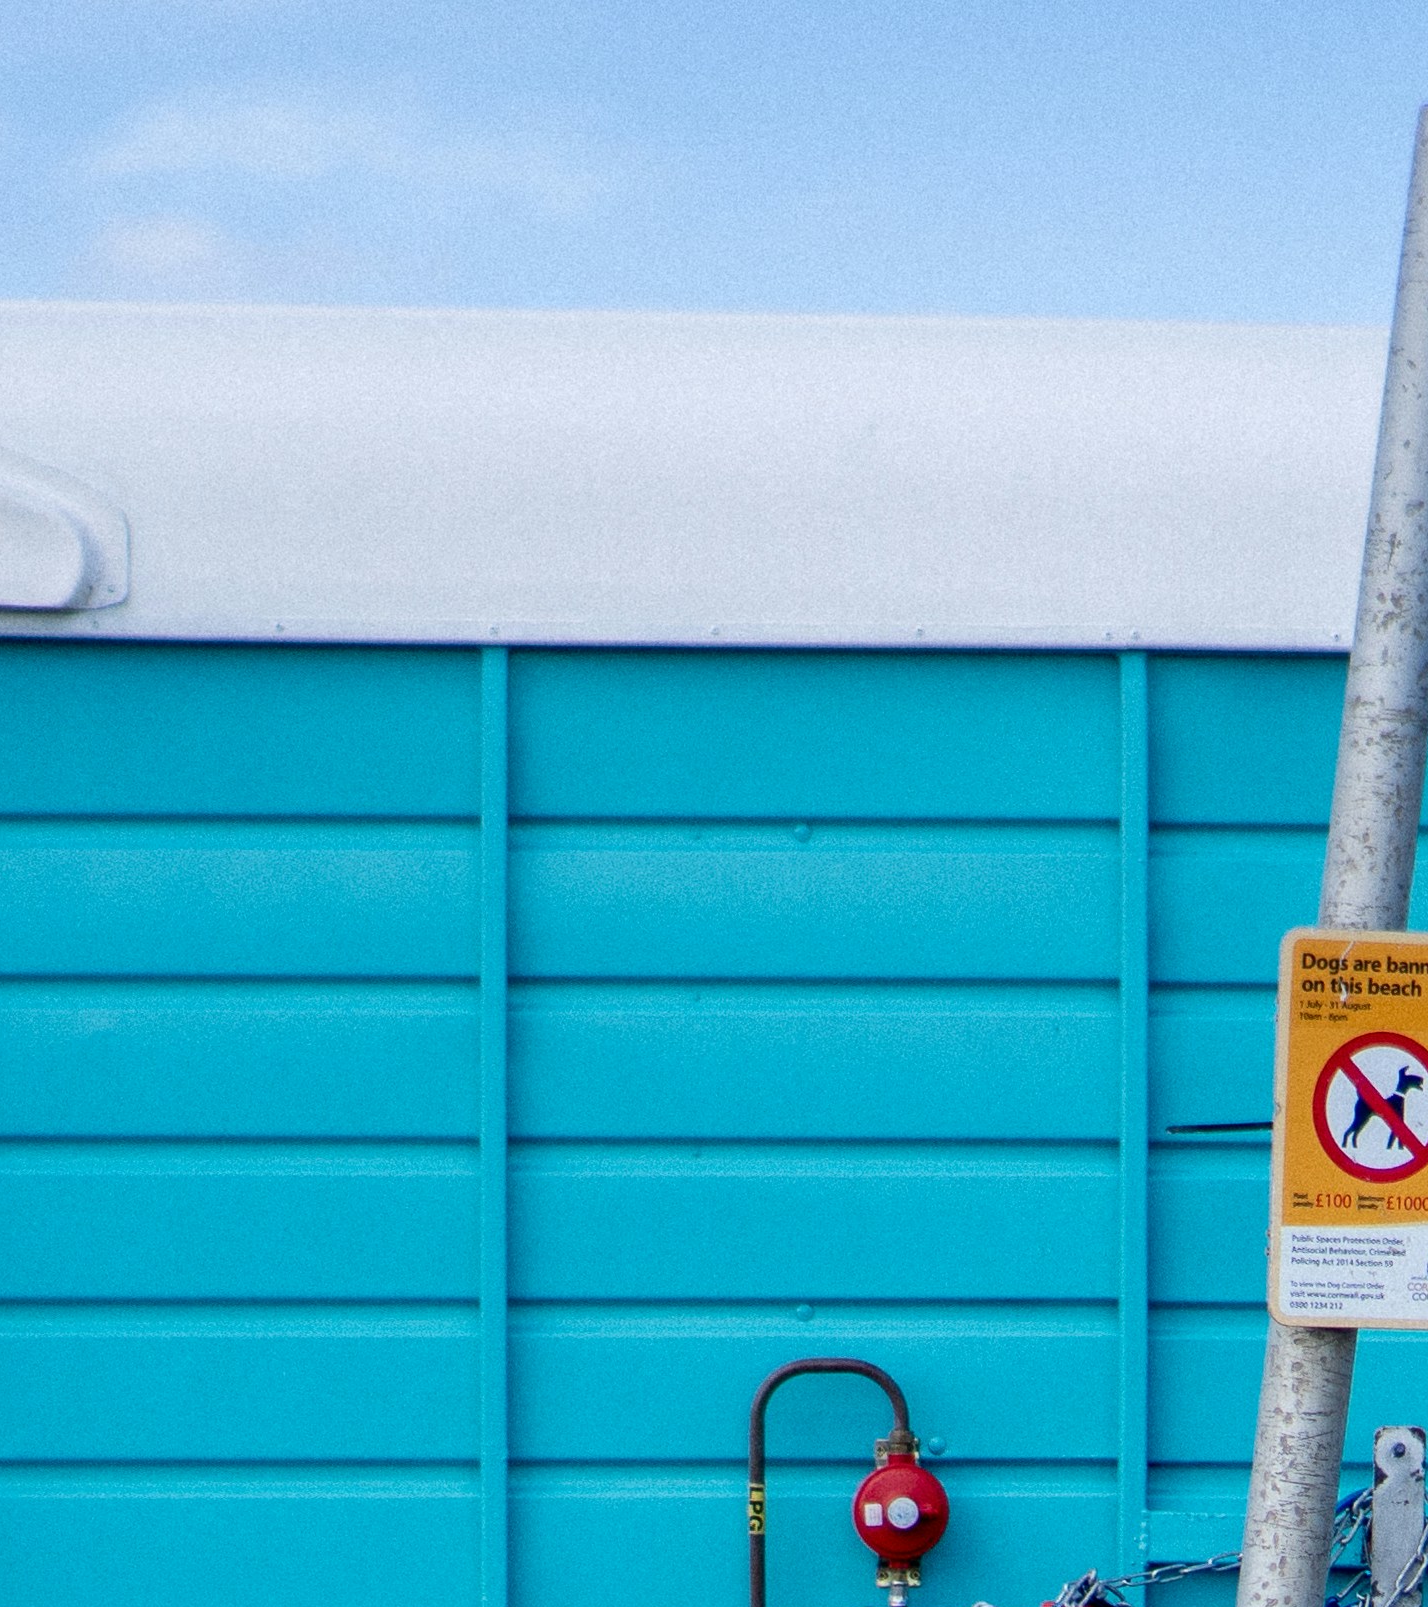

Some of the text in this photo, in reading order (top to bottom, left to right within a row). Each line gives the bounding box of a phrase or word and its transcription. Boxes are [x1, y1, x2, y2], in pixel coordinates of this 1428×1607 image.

[1301, 953, 1348, 975] Dogs
[1353, 958, 1382, 972] are
[1302, 976, 1422, 997] on this beach
[1307, 1000, 1323, 1011] July
[1329, 1001, 1339, 1009] 31
[1341, 1001, 1371, 1012] August
[1315, 1193, 1352, 1209] £100
[1291, 1234, 1314, 1242] Public
[1316, 1235, 1341, 1245] Spaces
[1342, 1236, 1381, 1245] Protection
[1291, 1246, 1327, 1254] Antisocial
[1369, 1248, 1392, 1256] Crime
[1291, 1257, 1320, 1267] Policing
[1322, 1258, 1334, 1266] Act
[1336, 1258, 1354, 1266] 2014
[1355, 1259, 1383, 1267] Section
[1327, 1281, 1341, 1290] Dog
[1289, 1301, 1343, 1310] 0300 1234 212
[749, 1486, 765, 1532] LPG
